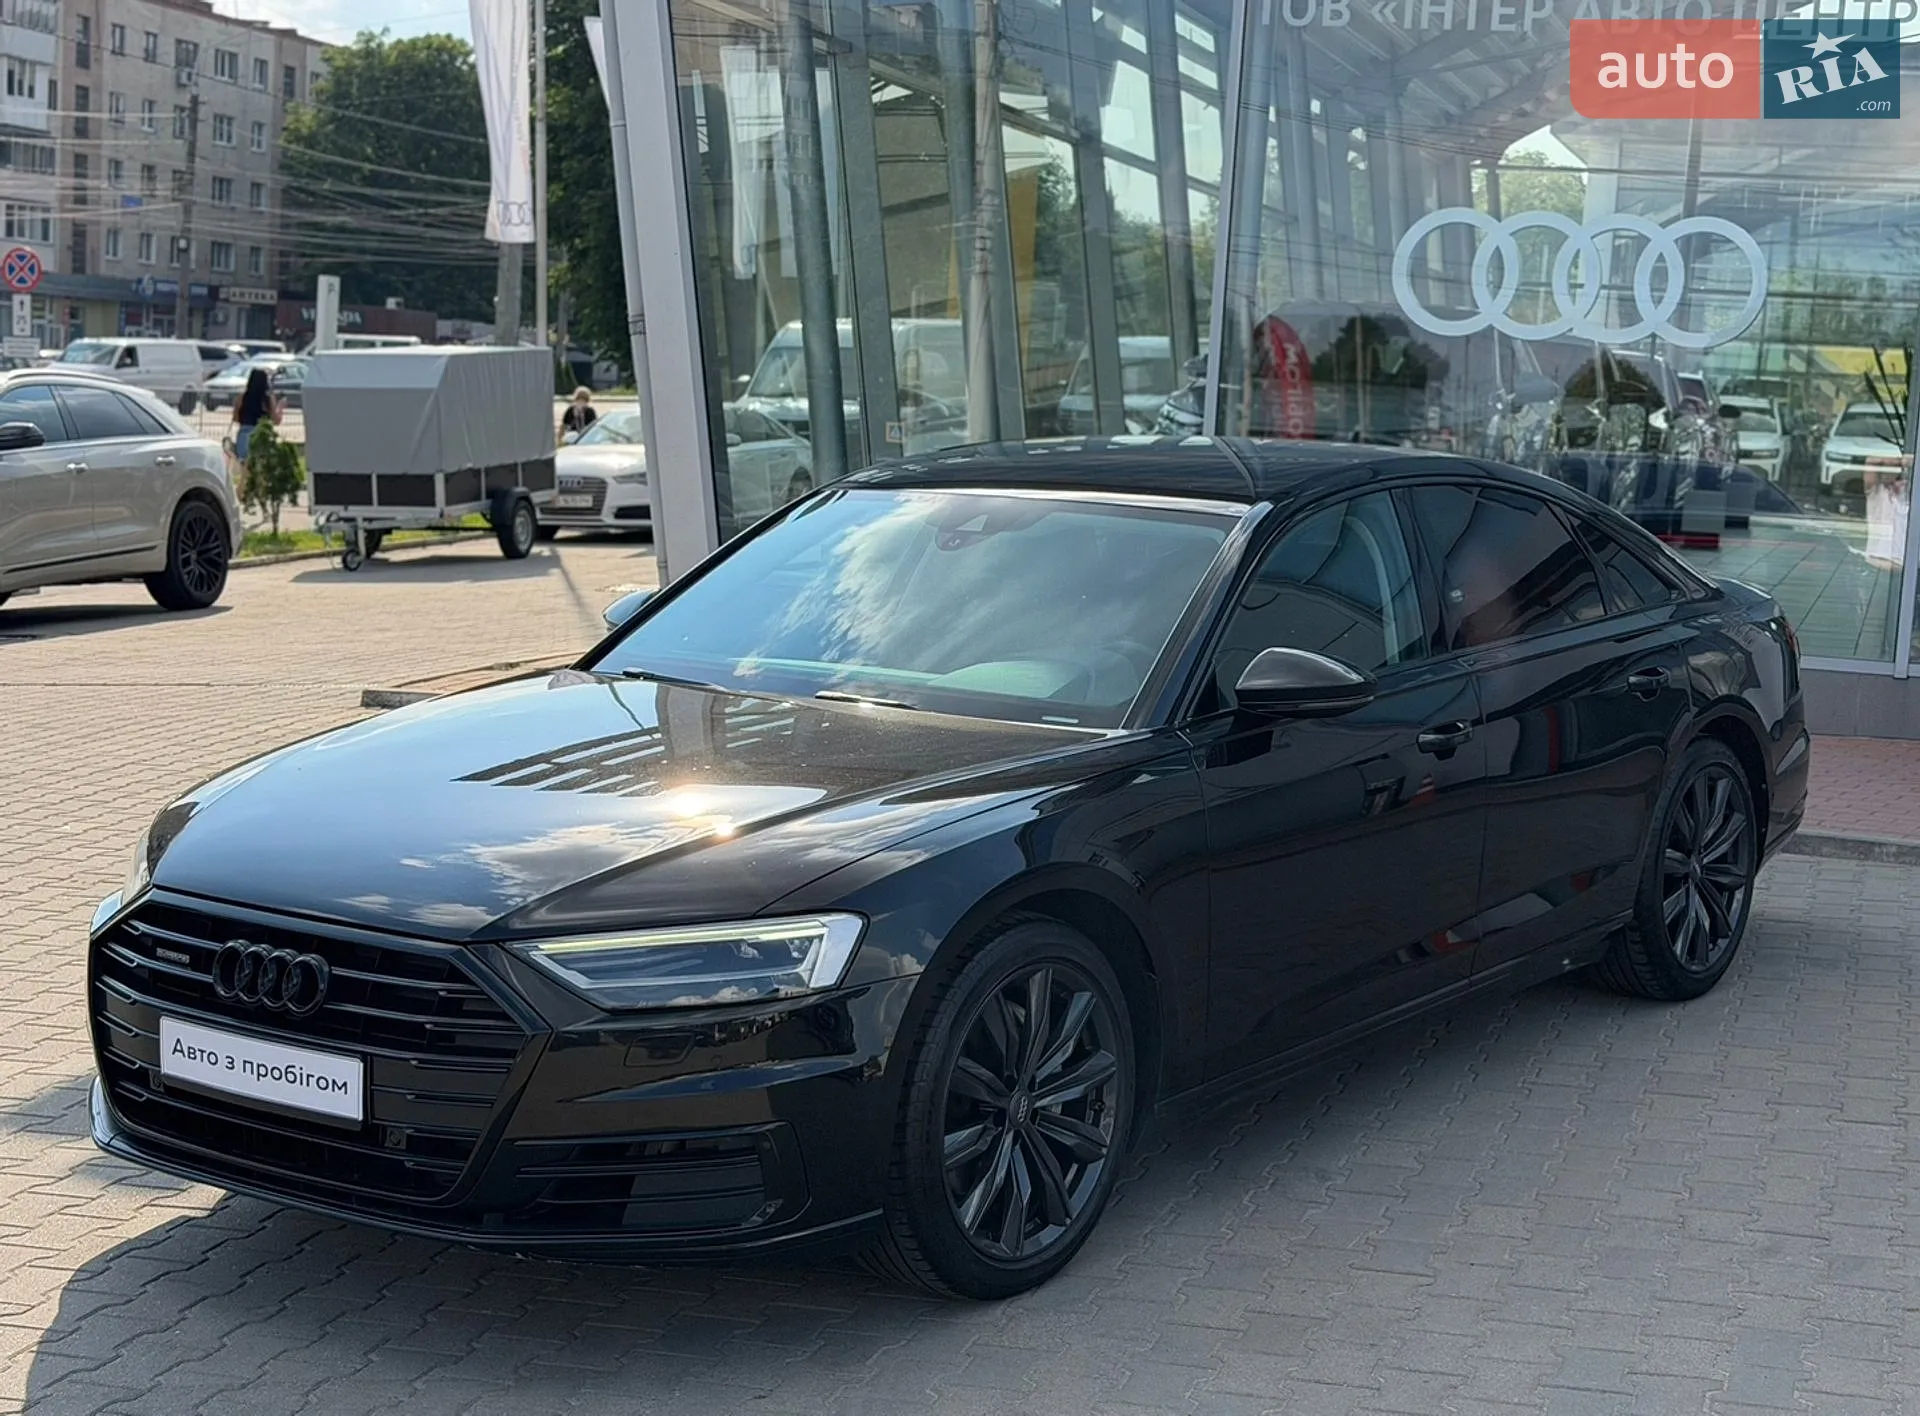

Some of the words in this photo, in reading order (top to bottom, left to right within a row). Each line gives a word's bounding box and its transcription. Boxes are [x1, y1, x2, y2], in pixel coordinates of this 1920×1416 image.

[172, 1038, 219, 1066] Авто
[225, 1055, 235, 1070] з
[242, 1059, 348, 1095] пробігом
